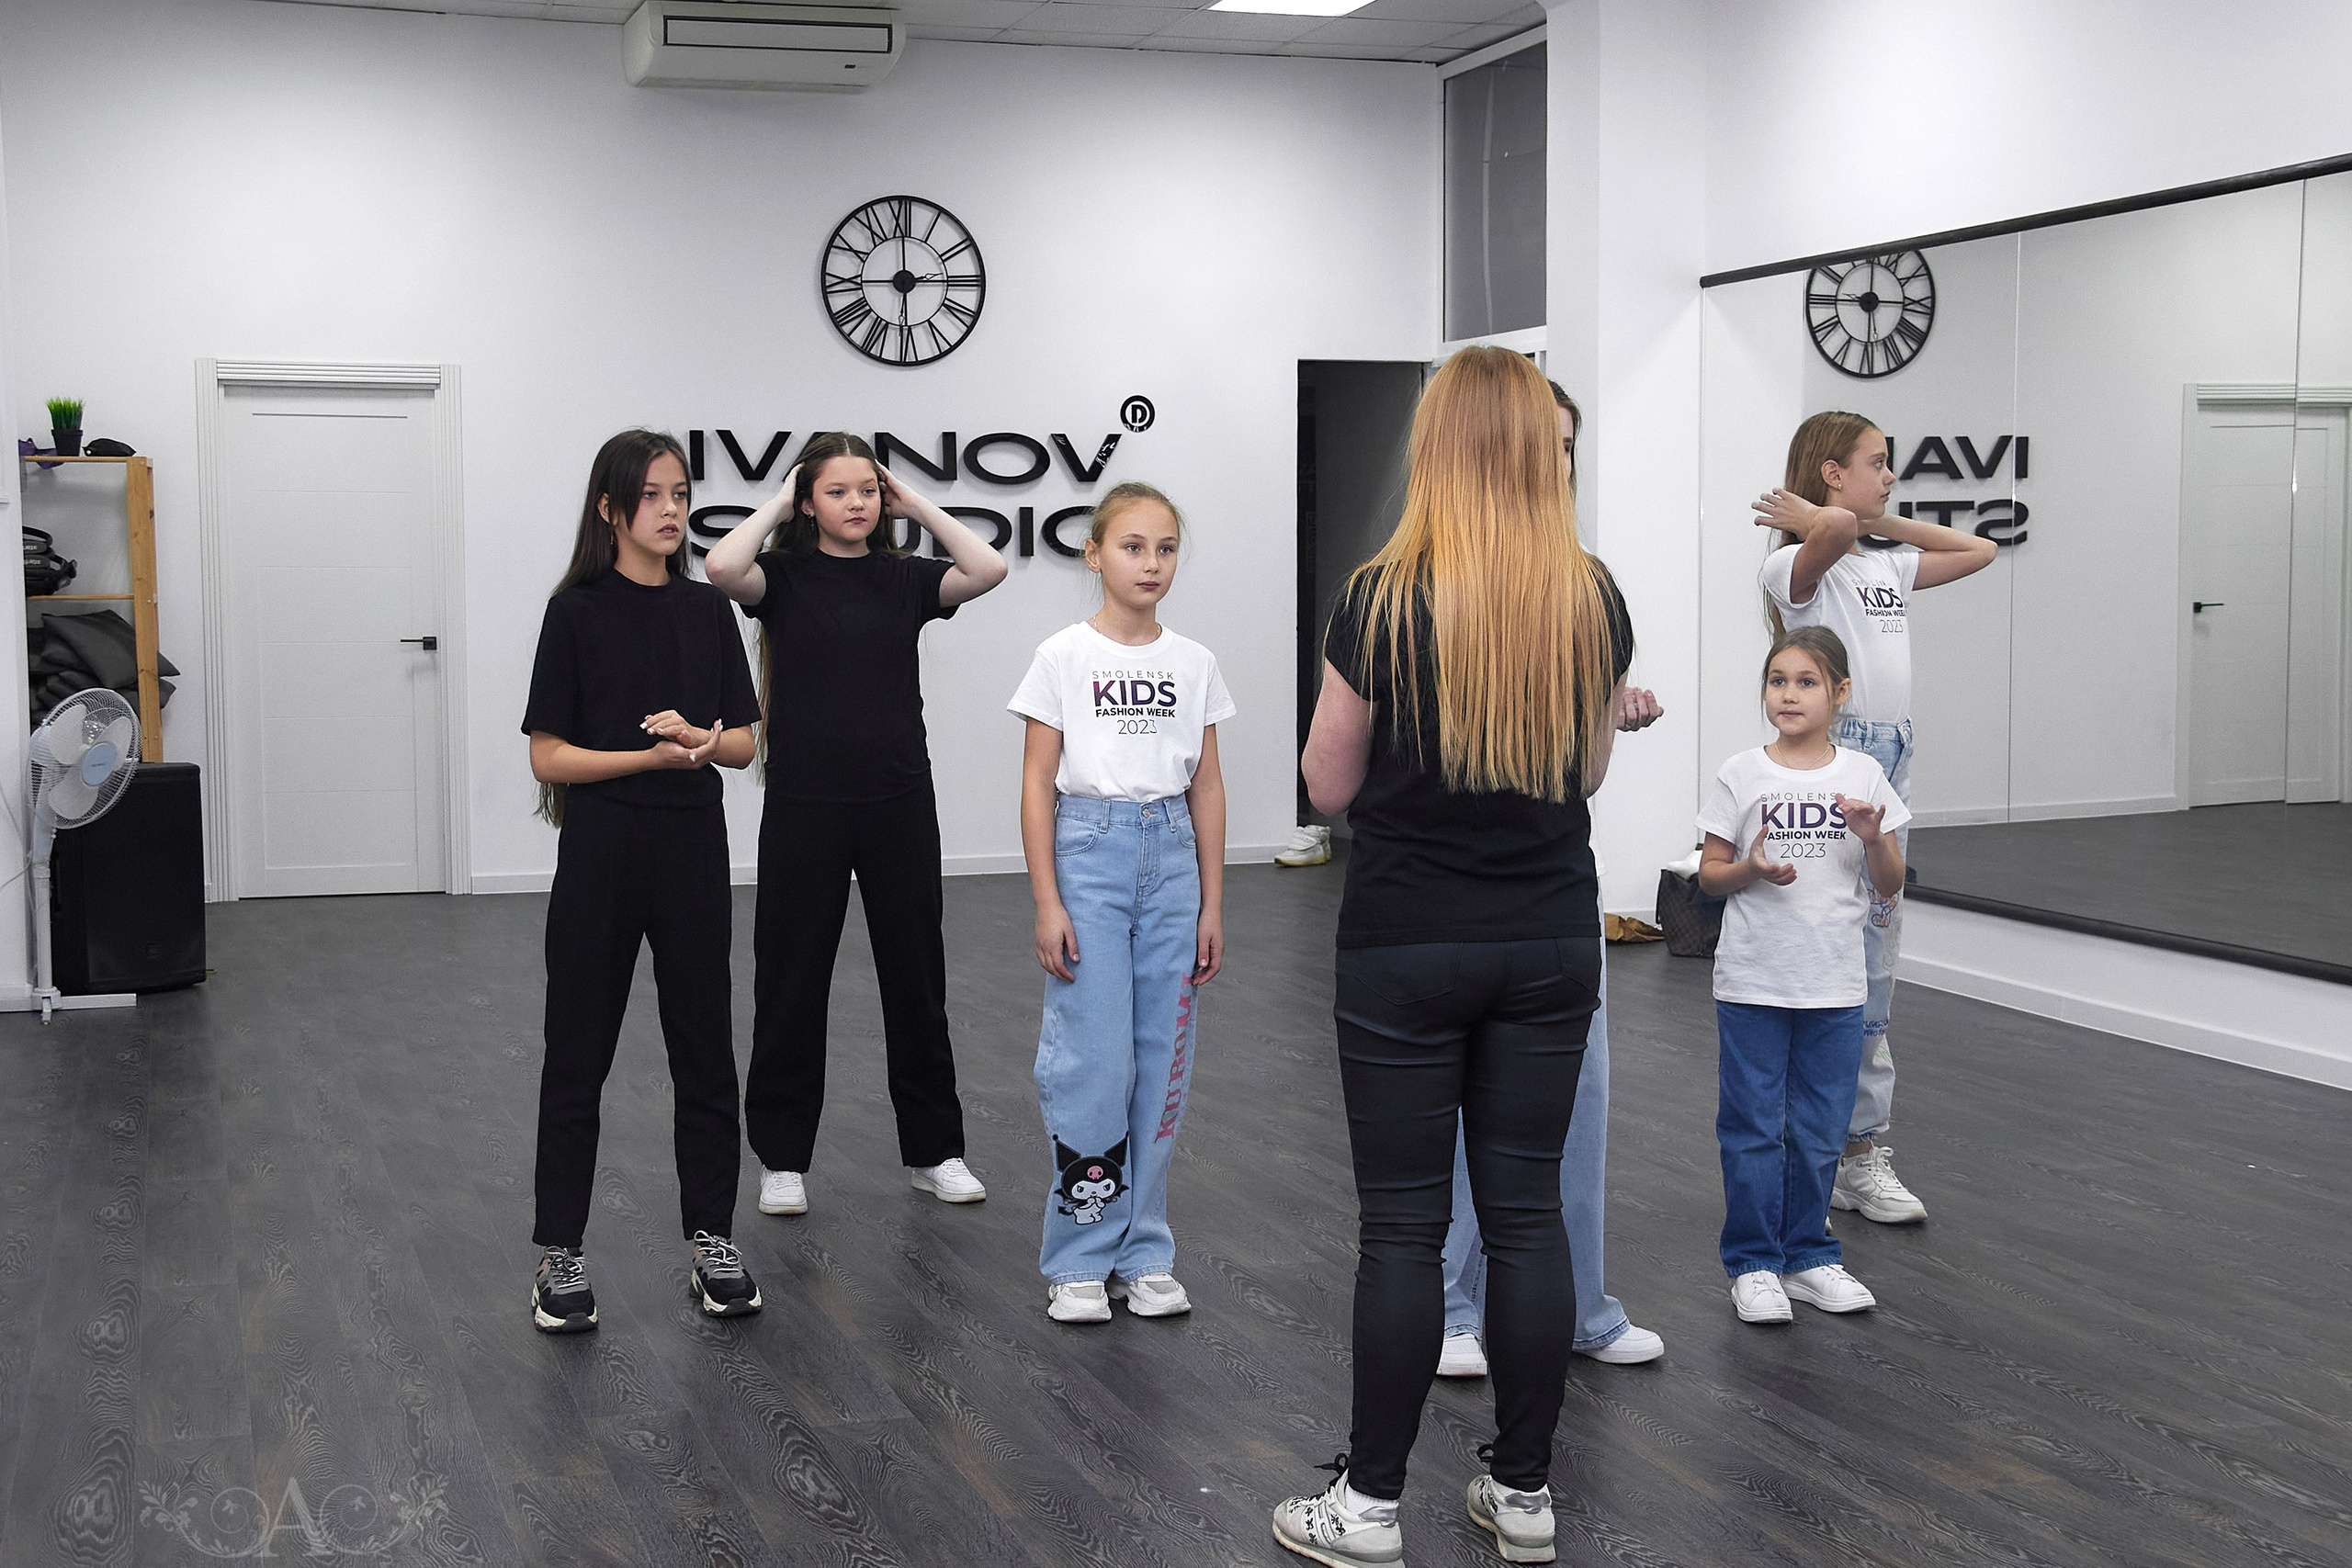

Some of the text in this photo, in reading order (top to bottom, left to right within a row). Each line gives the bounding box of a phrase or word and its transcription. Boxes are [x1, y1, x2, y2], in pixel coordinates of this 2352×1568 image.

[688, 429, 1123, 485] IVNOV
[688, 505, 1093, 558] SDIO
[1856, 587, 1904, 608] KIDS
[1879, 619, 1904, 633] 2023
[1092, 670, 1174, 680] SMOLENSK
[1092, 680, 1177, 707] KIDS
[1095, 707, 1176, 718] FASHION WEEK
[1116, 719, 1158, 735] 2023
[1760, 792, 1846, 802] SMOLENS
[1761, 802, 1848, 829] KIDS
[1764, 830, 1847, 841] ASHION WEEK
[1780, 842, 1826, 859] 2023
